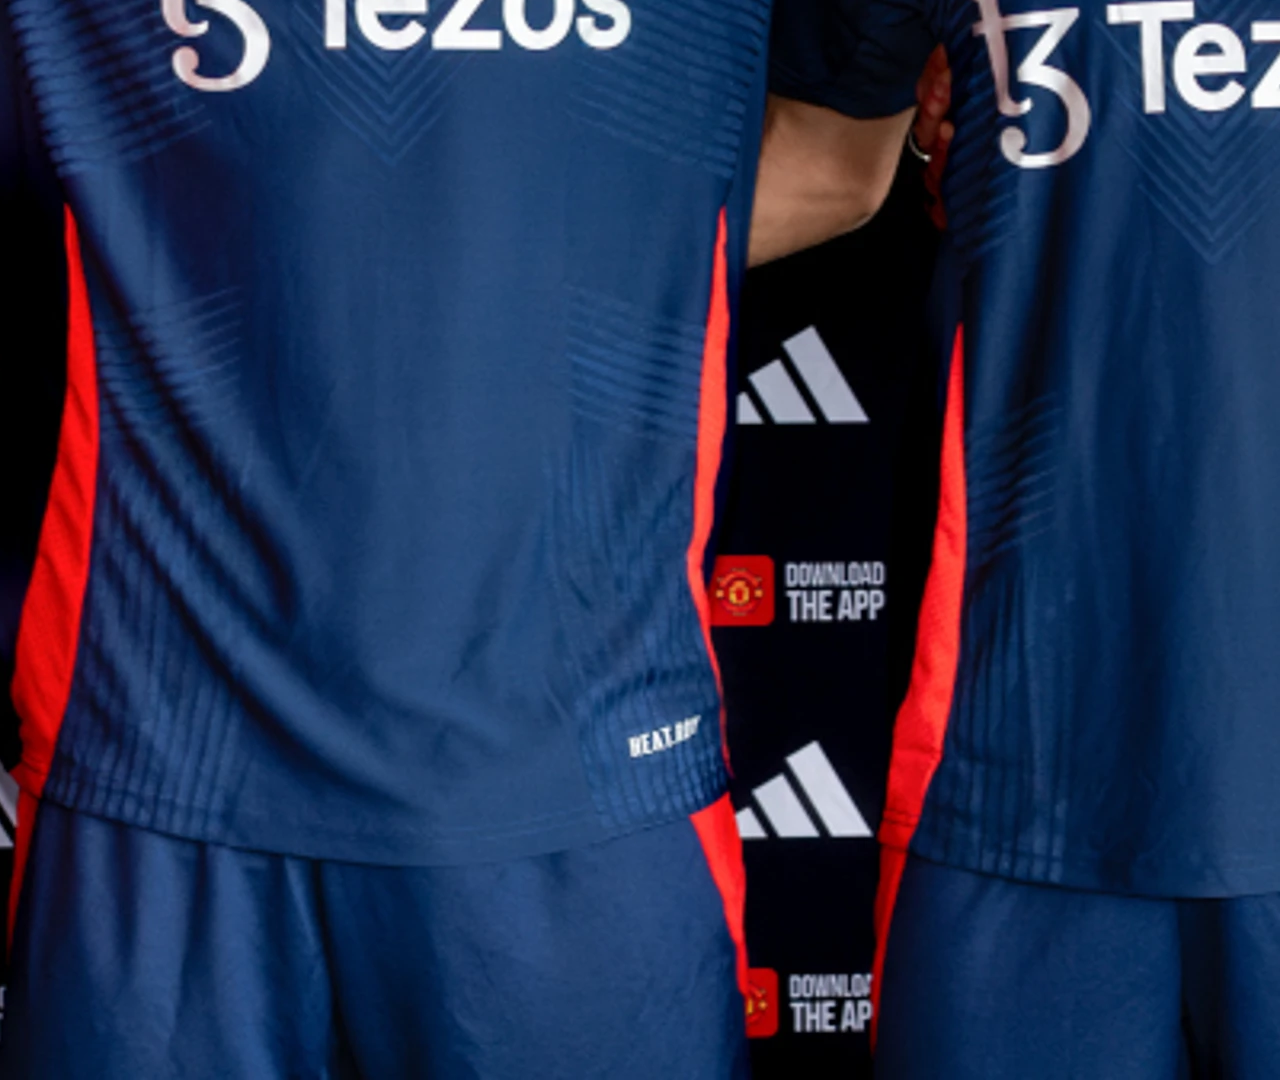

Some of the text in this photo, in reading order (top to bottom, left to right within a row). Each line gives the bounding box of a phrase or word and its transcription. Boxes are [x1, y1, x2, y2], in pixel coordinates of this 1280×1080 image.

[786, 562, 884, 587] DOWNLOAD
[787, 589, 884, 621] THE APP
[790, 1000, 872, 1032] THE AP
